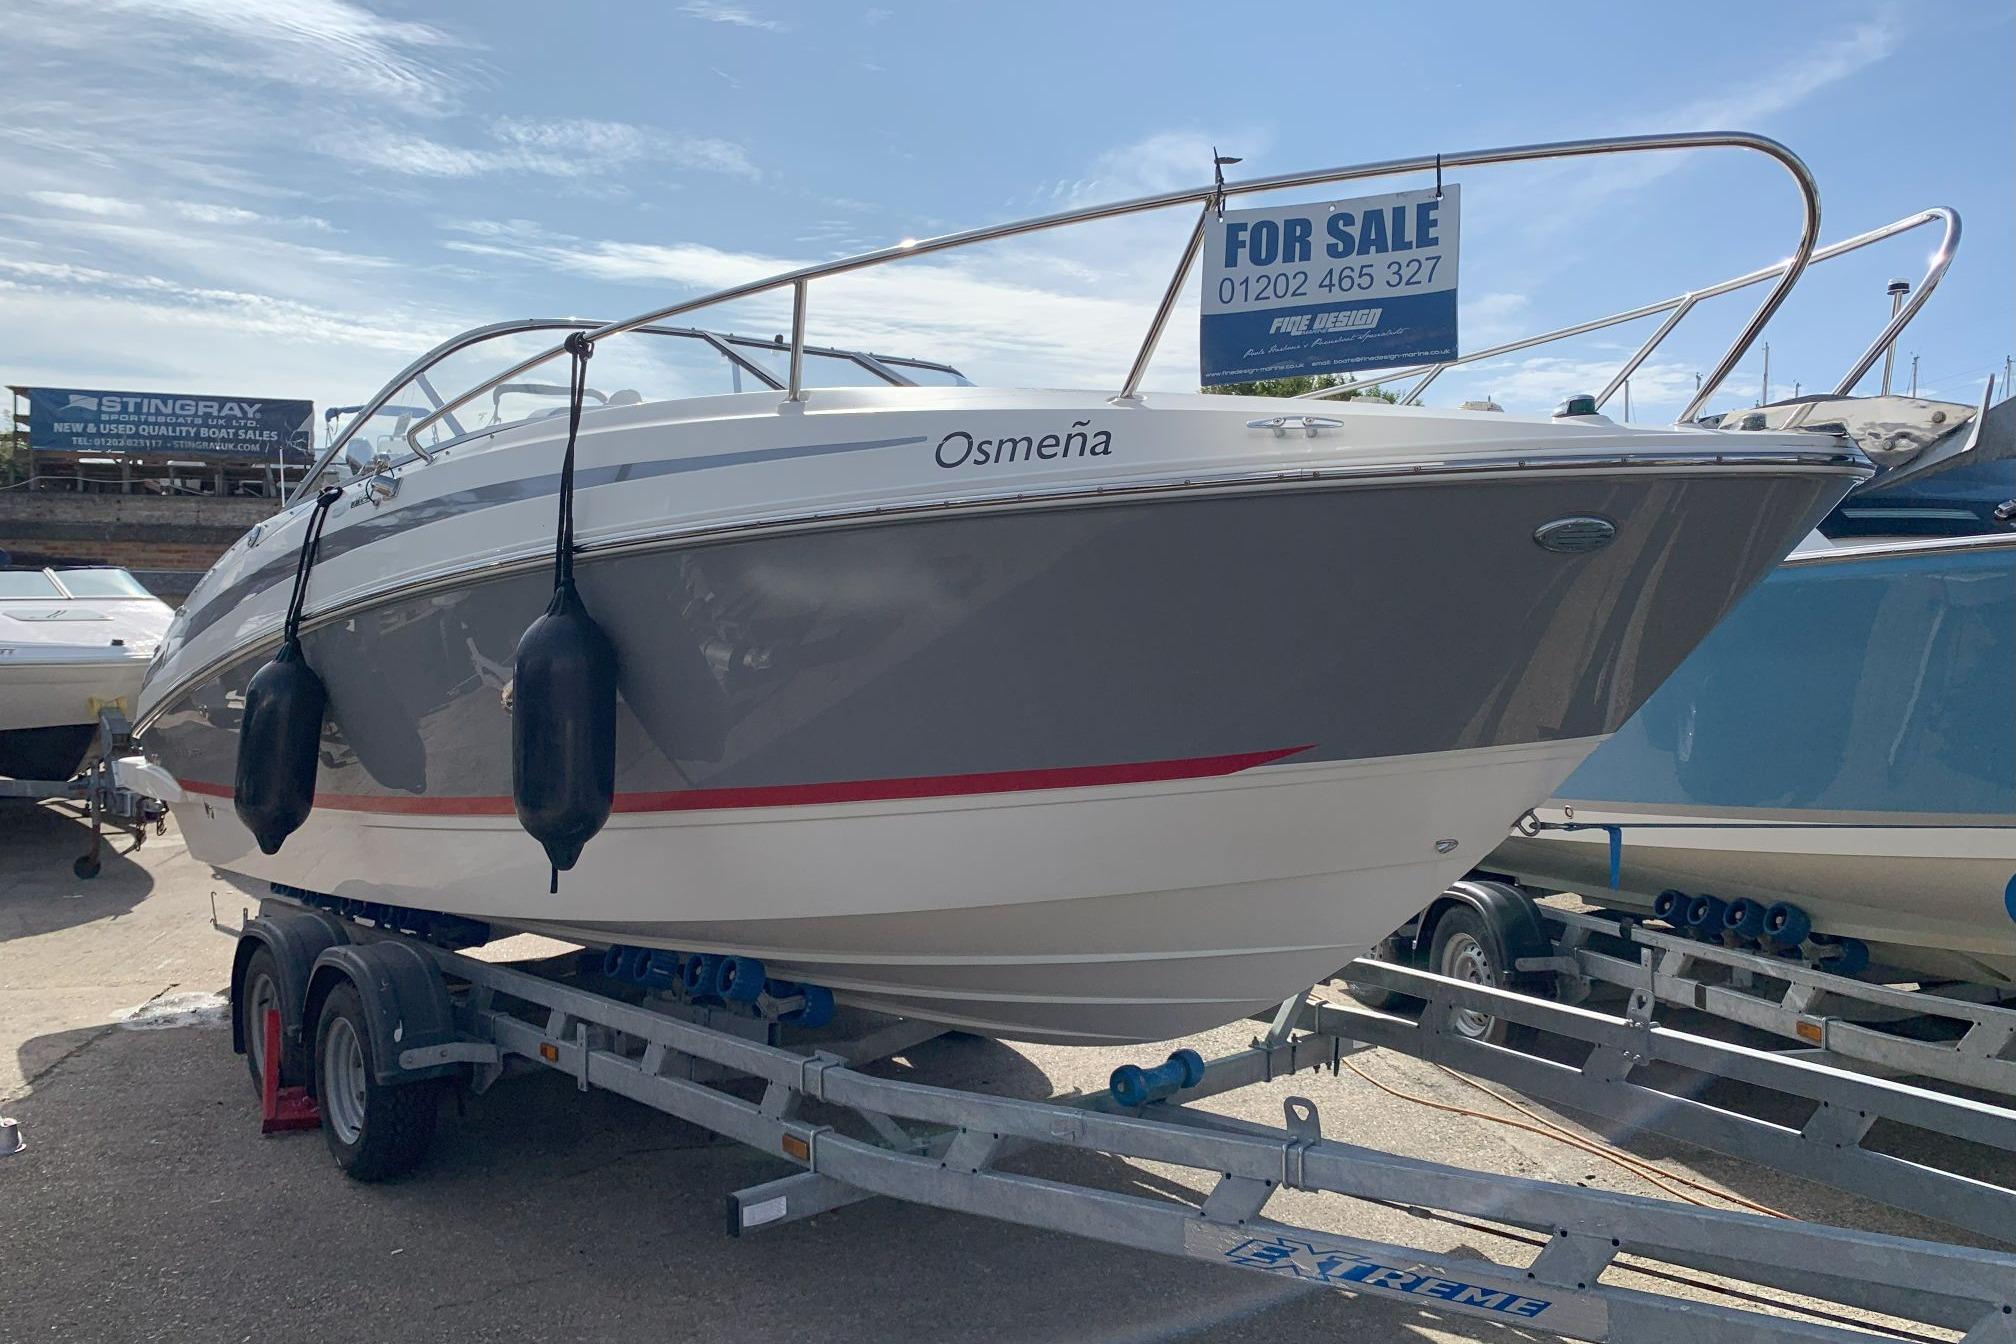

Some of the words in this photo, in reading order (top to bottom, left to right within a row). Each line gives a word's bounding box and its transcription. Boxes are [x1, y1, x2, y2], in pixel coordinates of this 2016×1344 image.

[1225, 218, 1312, 268] FOR
[1326, 201, 1439, 259] SALE
[1218, 271, 1308, 304] 01202
[1318, 264, 1374, 294] 465
[1385, 255, 1442, 288] 327
[1269, 314, 1312, 336] FINE
[1313, 308, 1382, 332] DESIGN
[101, 397, 262, 418] STINGRAY
[101, 414, 202, 424] SPORTSBOATS
[208, 418, 226, 426] UK
[232, 419, 260, 428] LTD.
[53, 422, 84, 433] NEW
[86, 423, 97, 433] &
[100, 423, 136, 434] USED
[138, 424, 197, 437] QUALITY
[200, 427, 235, 439] BOAT
[237, 429, 278, 441] SALES
[71, 437, 92, 445] TEL:
[94, 438, 124, 447] 01202
[935, 419, 1112, 469] Osmeña
[1224, 1237, 1553, 1318] EXTREME
